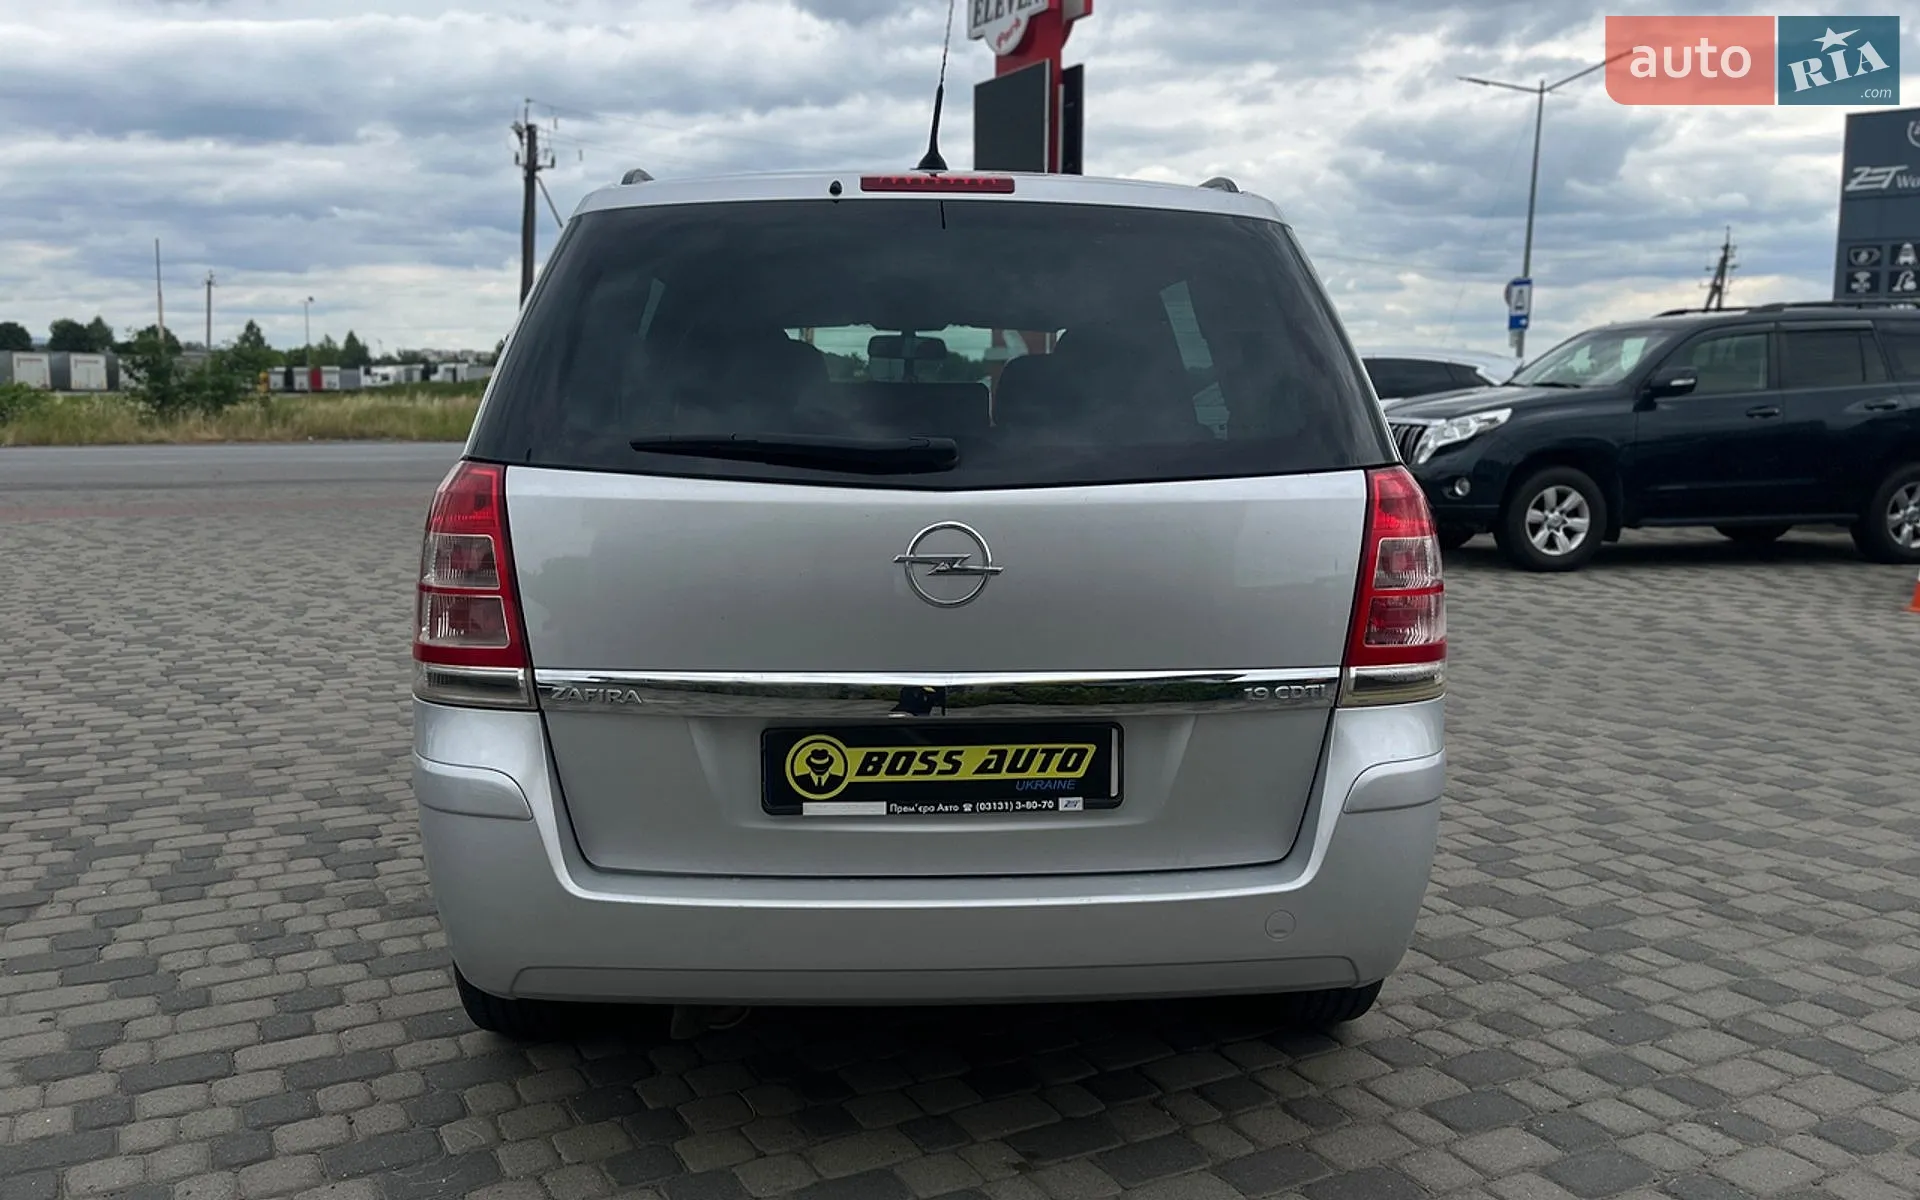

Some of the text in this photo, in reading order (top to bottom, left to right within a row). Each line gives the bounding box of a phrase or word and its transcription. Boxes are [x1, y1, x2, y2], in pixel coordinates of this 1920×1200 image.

[551, 686, 643, 704] ZAFIRA
[1274, 684, 1326, 699] CDTI
[855, 748, 1089, 776] BOSS AUTO
[1016, 779, 1075, 791] UKRAINE
[975, 801, 1014, 813] (03131)
